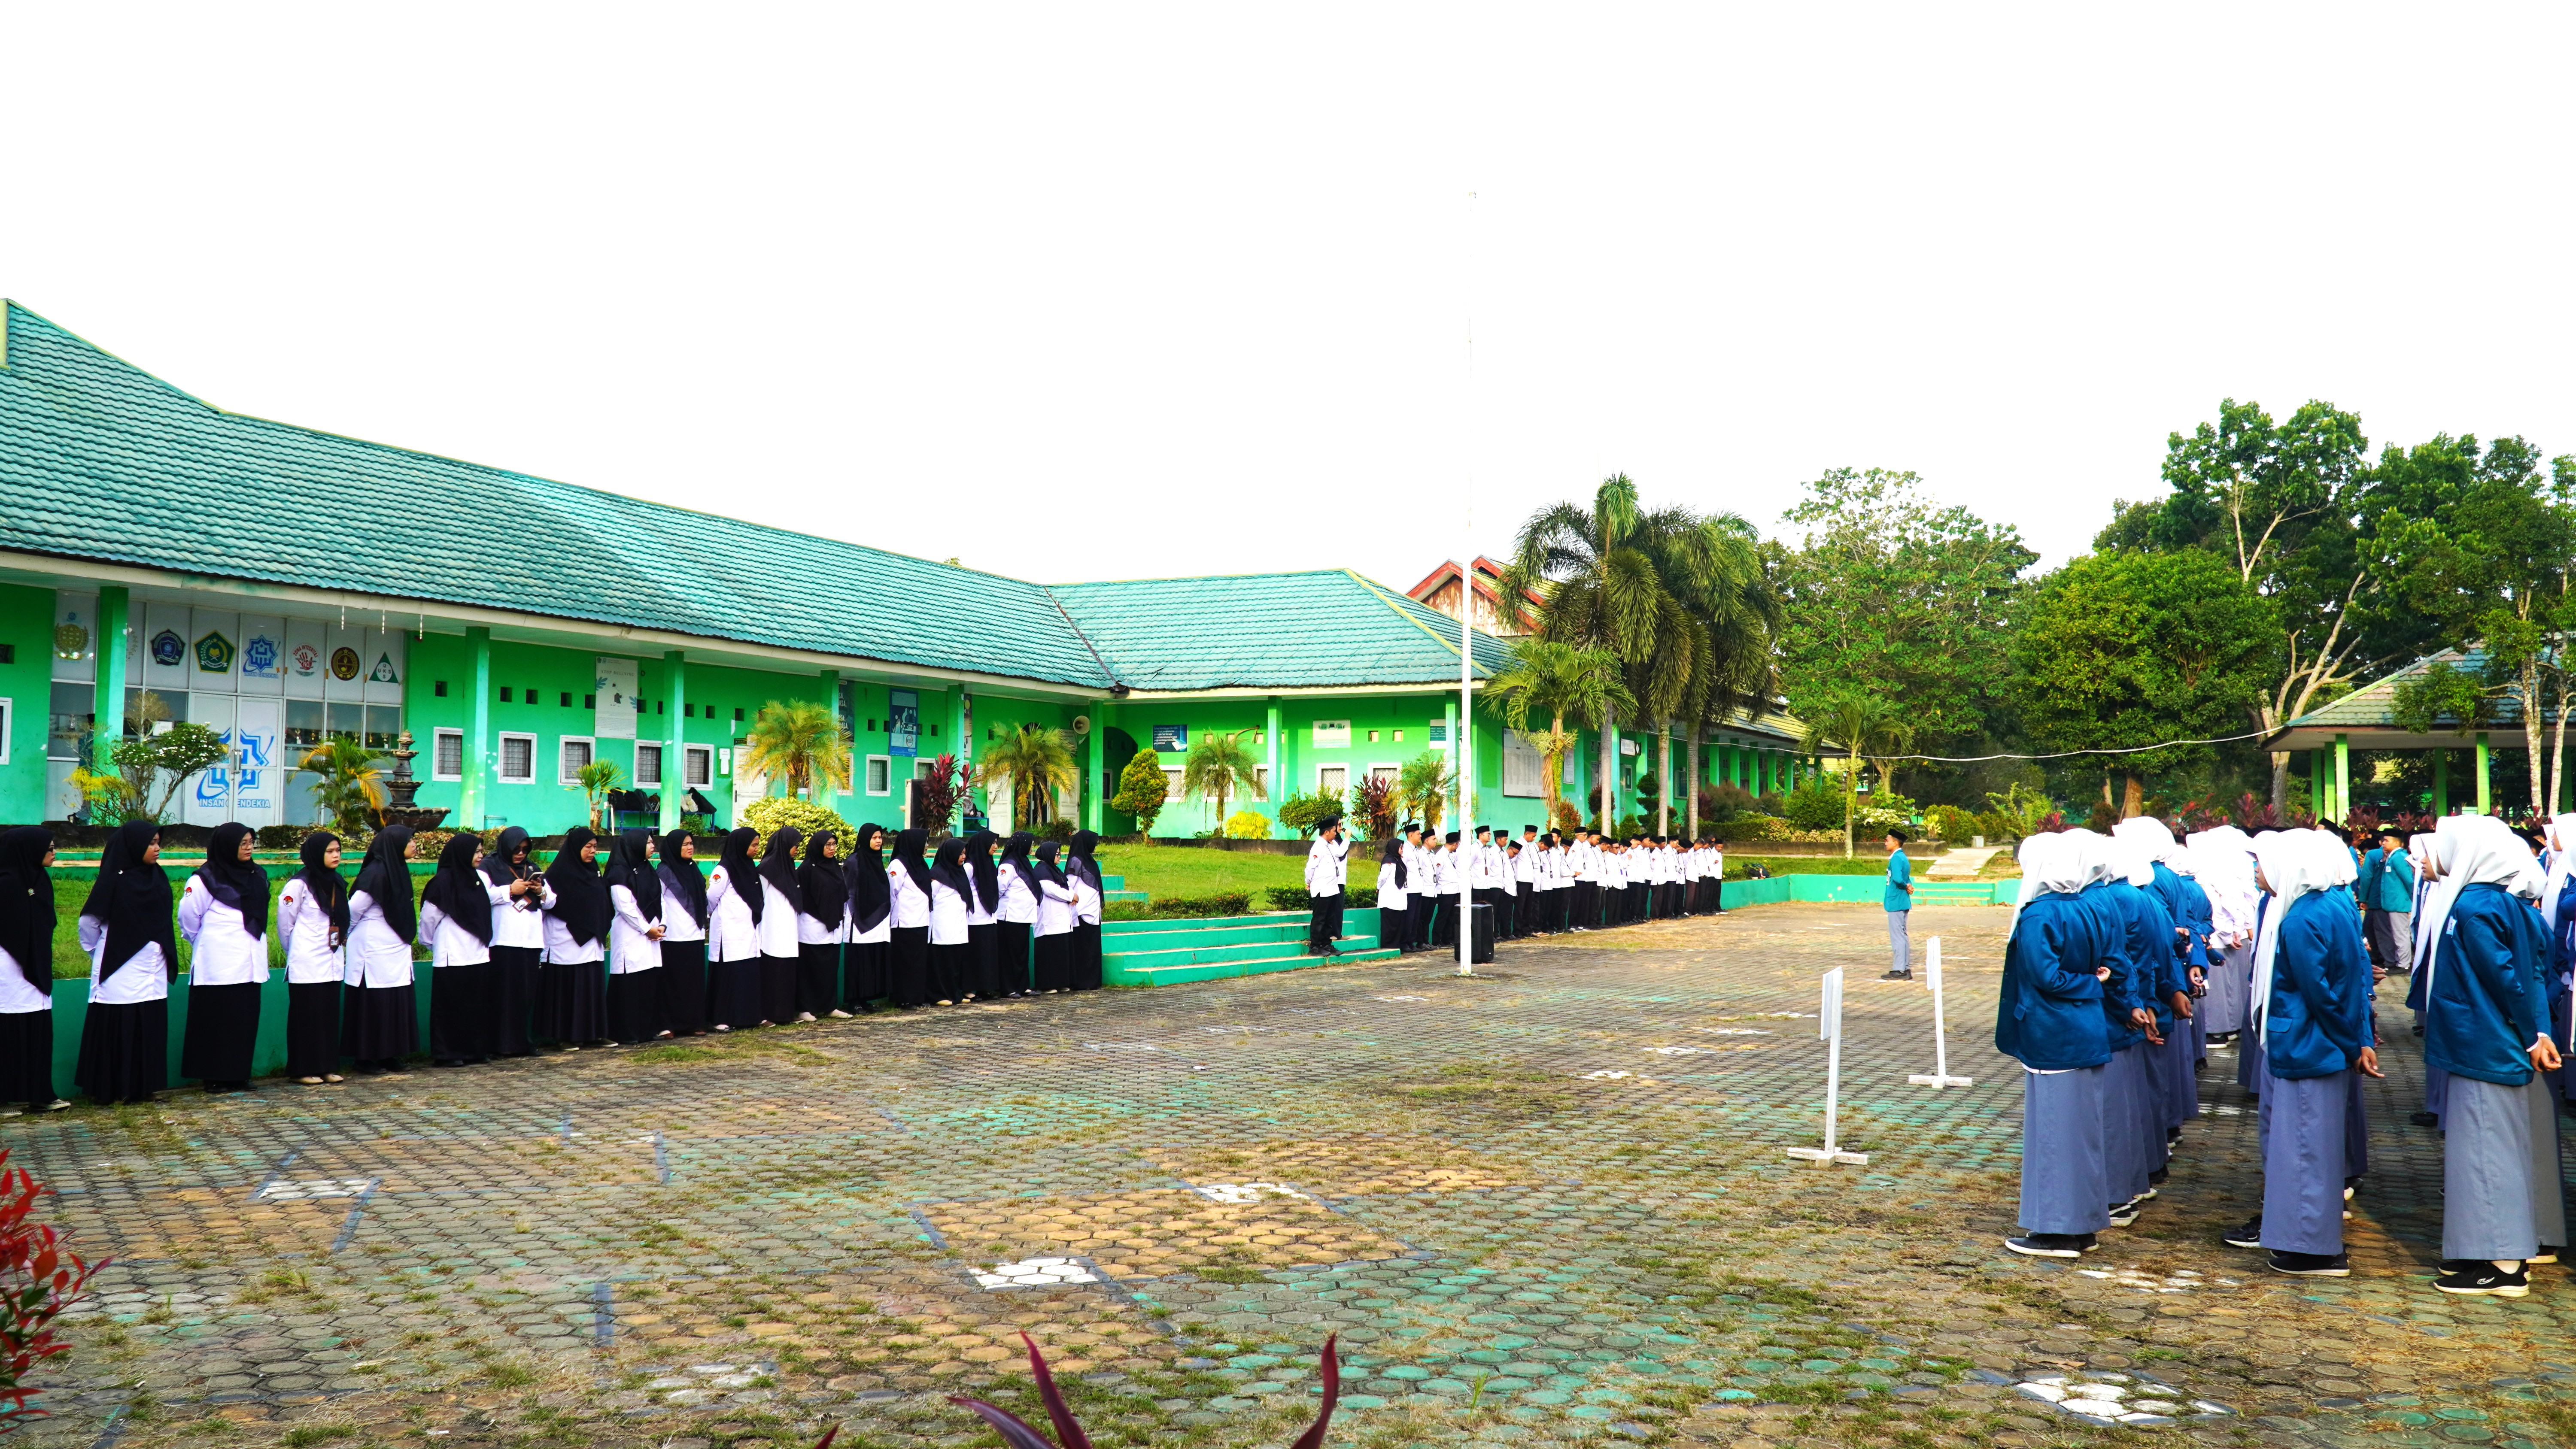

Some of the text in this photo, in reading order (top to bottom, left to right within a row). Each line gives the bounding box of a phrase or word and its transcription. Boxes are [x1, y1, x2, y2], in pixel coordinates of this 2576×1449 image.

[293, 645, 318, 658] ZONA INTEGRITAS
[199, 798, 224, 807] INSAN
